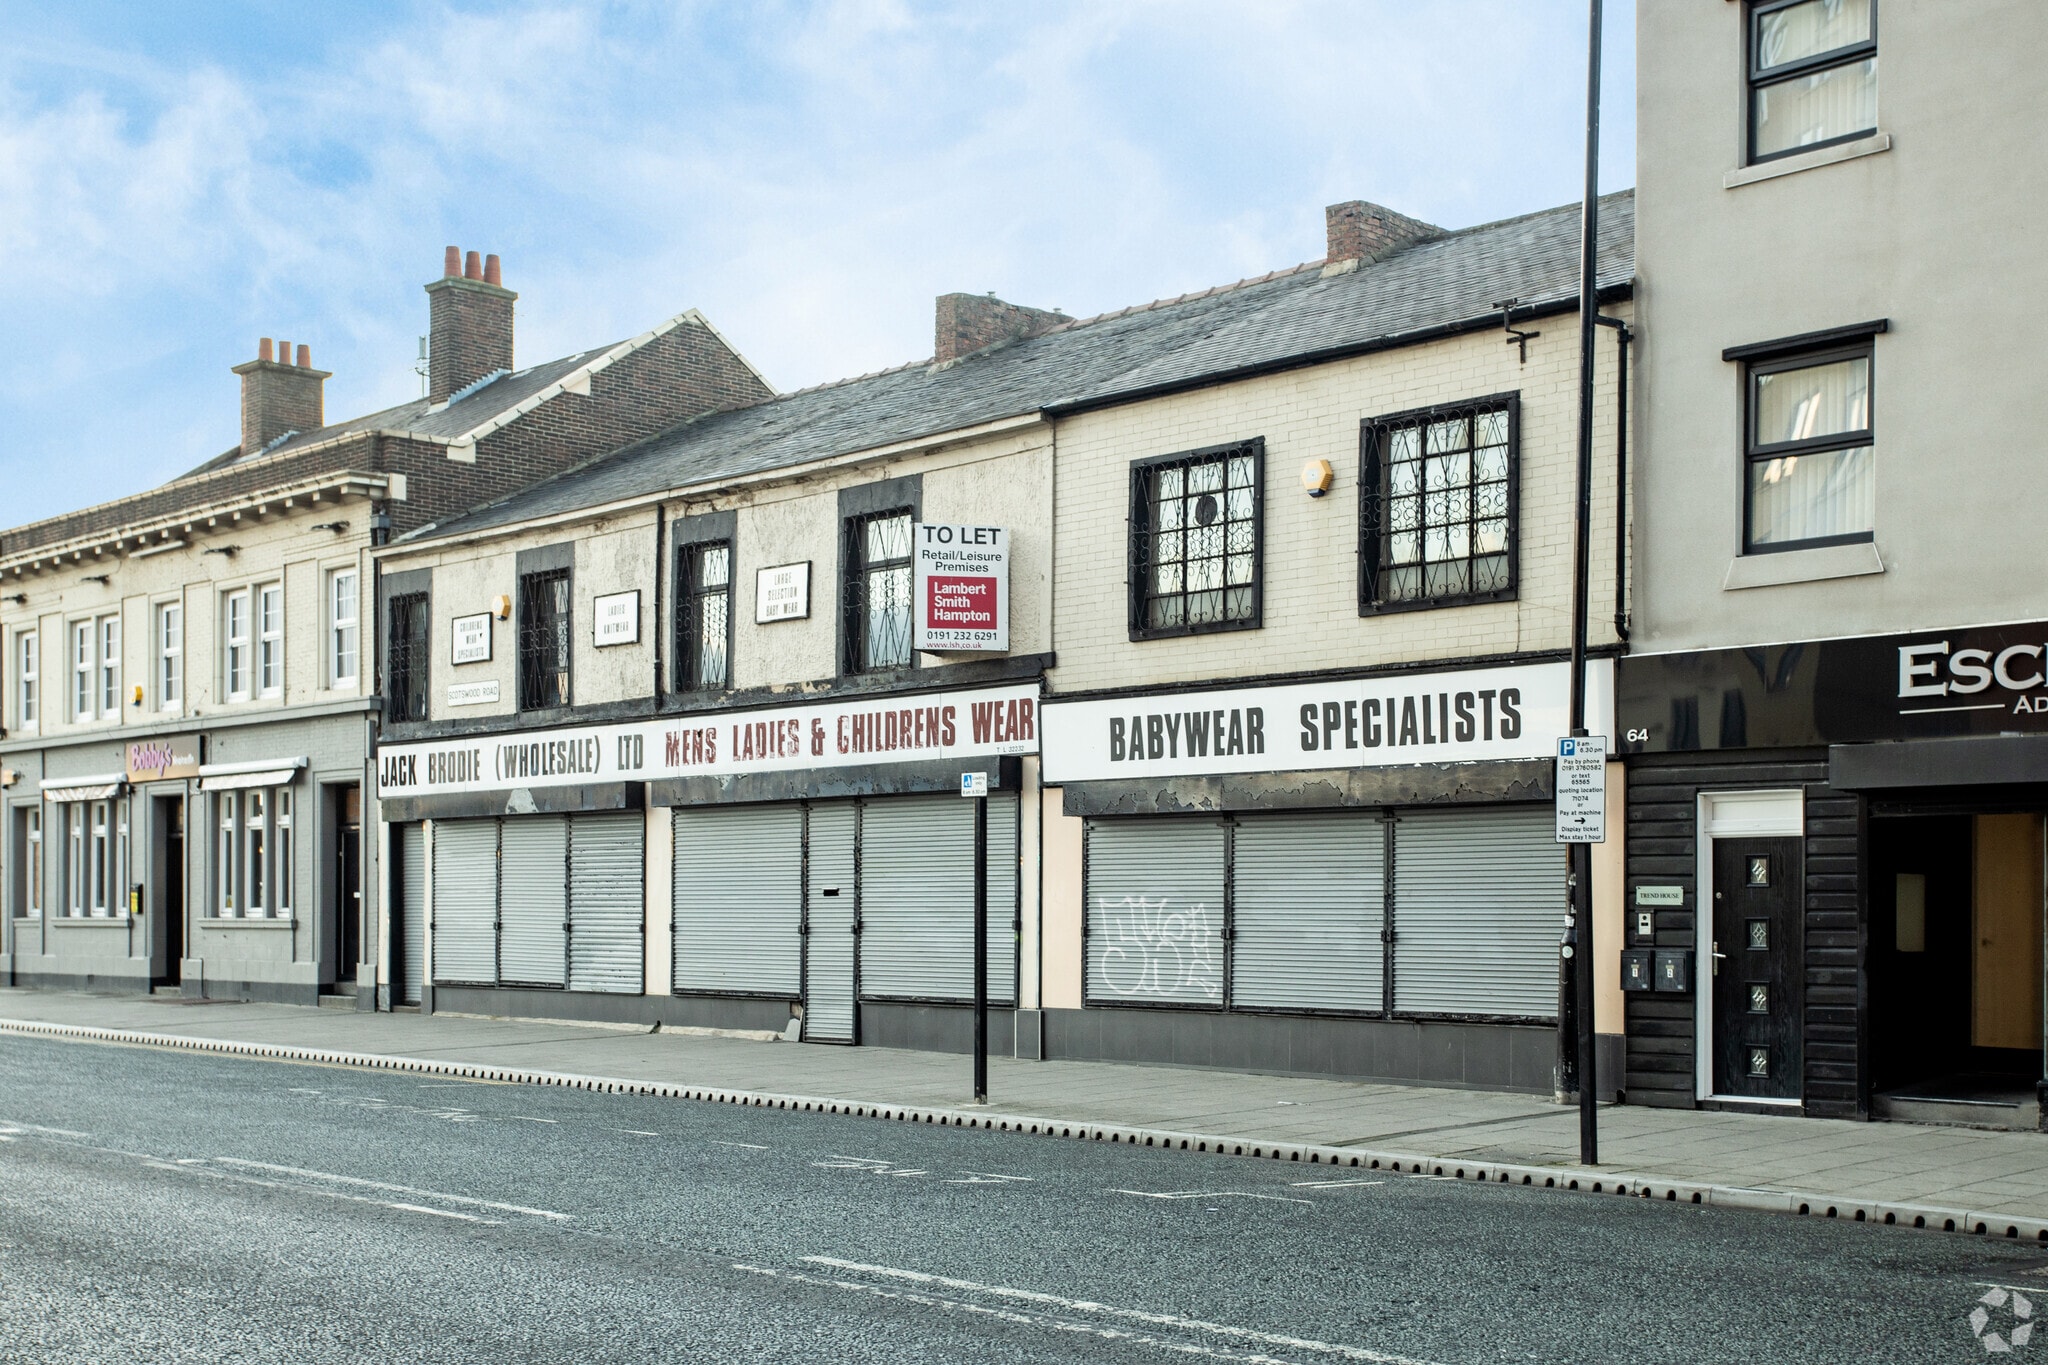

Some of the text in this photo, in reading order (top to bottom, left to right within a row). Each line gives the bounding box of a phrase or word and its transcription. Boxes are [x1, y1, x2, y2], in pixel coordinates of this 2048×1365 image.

[923, 526, 1001, 545] TO LET
[922, 549, 1002, 562] Retail/Leisure
[935, 562, 989, 573] Premises
[934, 581, 987, 595] Lambert
[934, 595, 971, 608] Smith
[934, 608, 991, 624] Hampton
[927, 631, 997, 641] 0191 232 6291
[926, 641, 983, 650] www.lsh.co.uk
[1897, 640, 2048, 698] ESC
[448, 686, 498, 700] SCOTSWOOD ROAD
[1110, 687, 1522, 762] BABYWEAR SPECIALISTS
[1626, 728, 1649, 742] 64
[381, 698, 1034, 787] JACK BRODIE (WHOLESALE) LTD MENS LADIES & CHILDRENS WEAR
[1563, 741, 1574, 755] P
[131, 742, 173, 776] Bobby's
